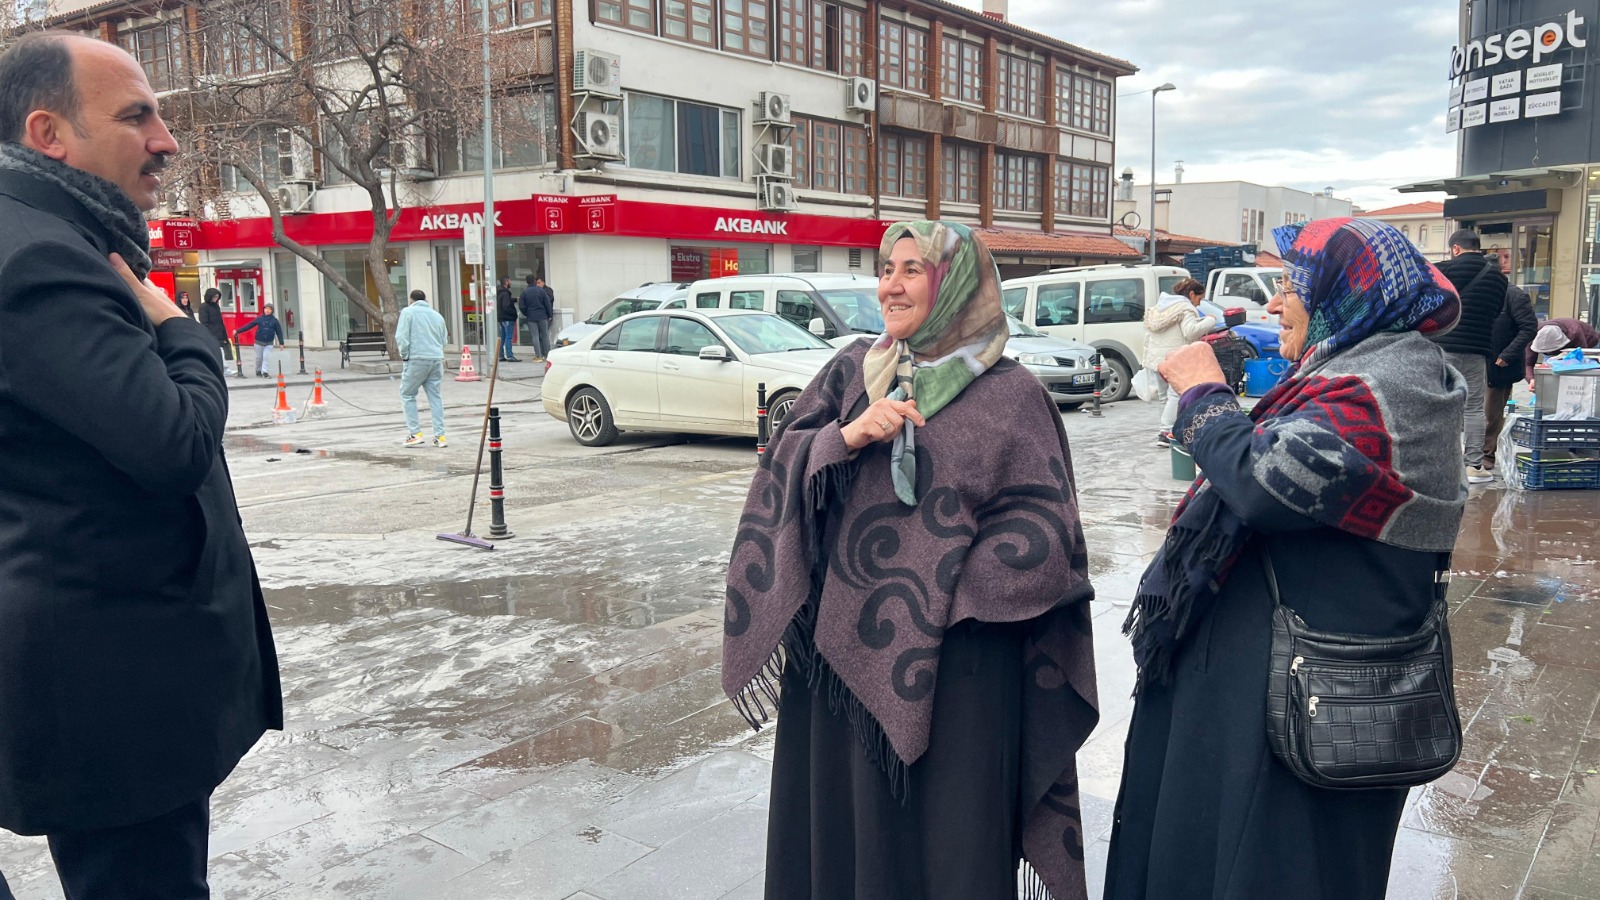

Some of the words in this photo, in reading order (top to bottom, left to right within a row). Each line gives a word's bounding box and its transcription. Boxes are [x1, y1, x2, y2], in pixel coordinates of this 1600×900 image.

[581, 196, 611, 204] AKBANK
[420, 210, 503, 231] AKBANK
[550, 220, 558, 228] 24
[592, 220, 600, 228] 24
[714, 217, 788, 235] AKBANK
[677, 253, 700, 262] Ekstra
